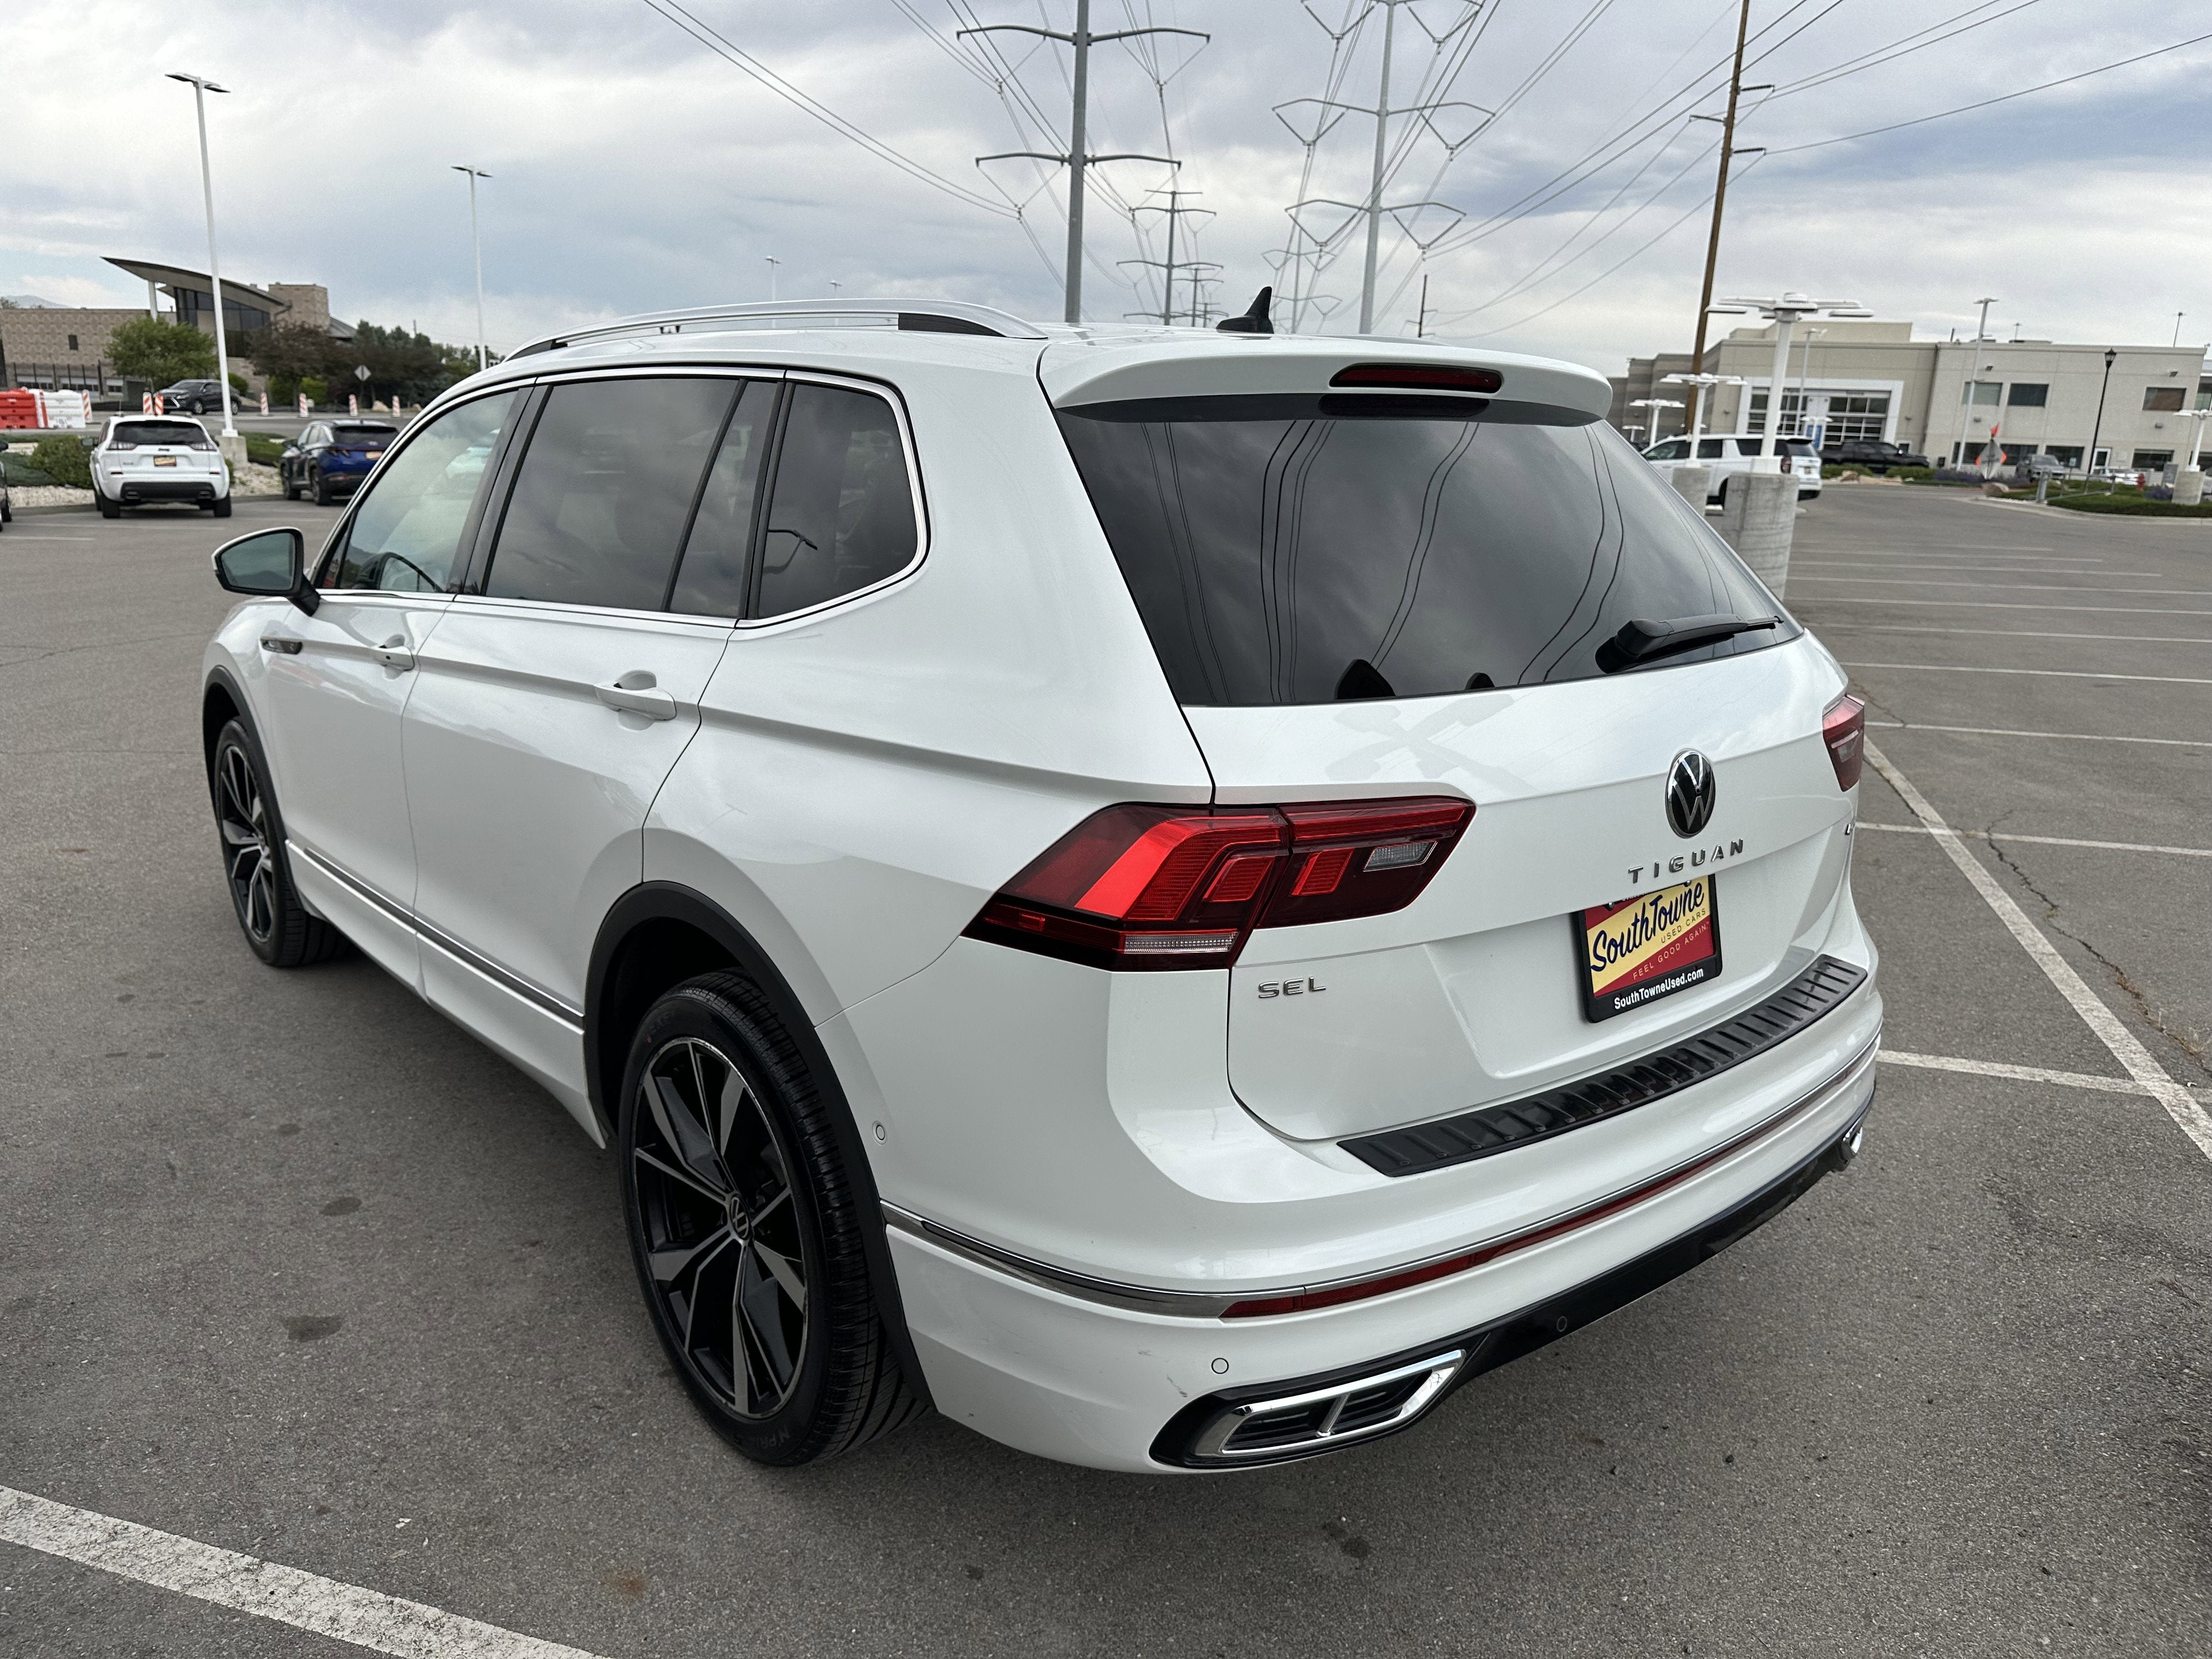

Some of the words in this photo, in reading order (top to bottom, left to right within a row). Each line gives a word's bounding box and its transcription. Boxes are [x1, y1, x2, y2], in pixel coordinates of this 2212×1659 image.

[1628, 838, 1743, 883] TIGUAN
[1591, 882, 1705, 972] SouthTowne
[1661, 925, 1682, 944] USED
[1685, 908, 1706, 926] CARS
[1633, 961, 1654, 980] FEEL
[1657, 943, 1680, 963] GOOD
[1259, 977, 1327, 998] SEL
[1614, 967, 1704, 1009] SouthTowneUsed.com
